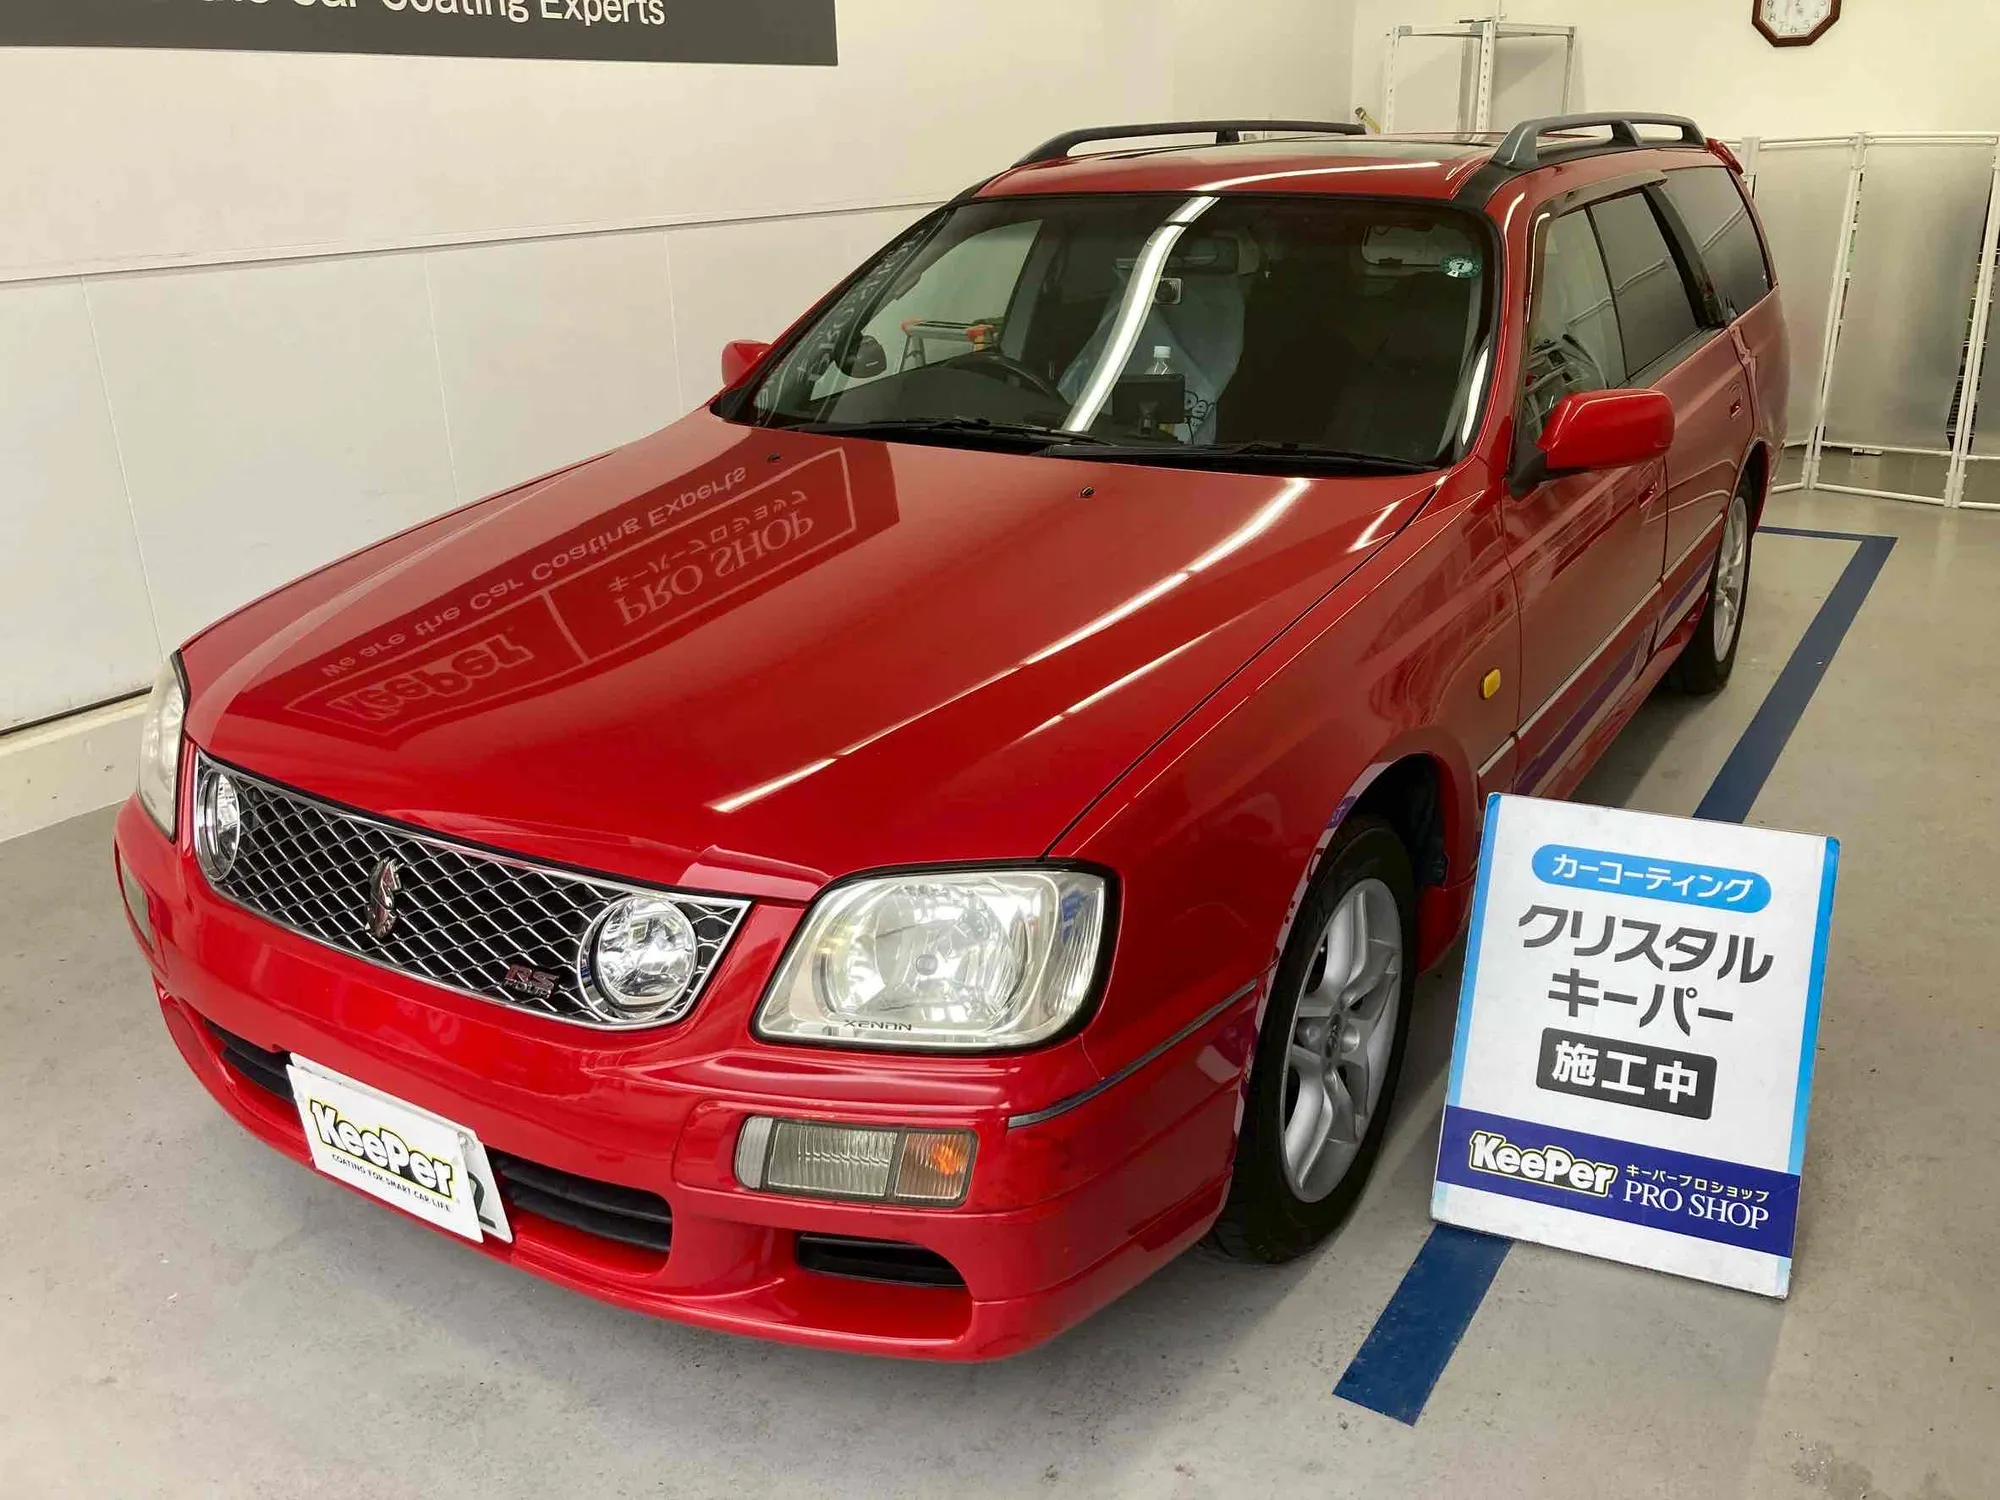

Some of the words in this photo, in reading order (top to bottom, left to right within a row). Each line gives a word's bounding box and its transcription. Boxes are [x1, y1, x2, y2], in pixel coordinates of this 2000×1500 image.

[1552, 854, 1753, 902] カーコーティング
[1518, 905, 1774, 983] クリスタル
[504, 964, 560, 989] RS
[1548, 968, 1734, 1037] キーパー
[1551, 1040, 1698, 1104] 施工中
[310, 1099, 453, 1199] KeePer
[1471, 1132, 1616, 1196] KeePer
[1623, 1180, 1682, 1211] PRO
[1688, 1194, 1769, 1230] SHOP
[1626, 1164, 1769, 1202] キーパープロショップ
